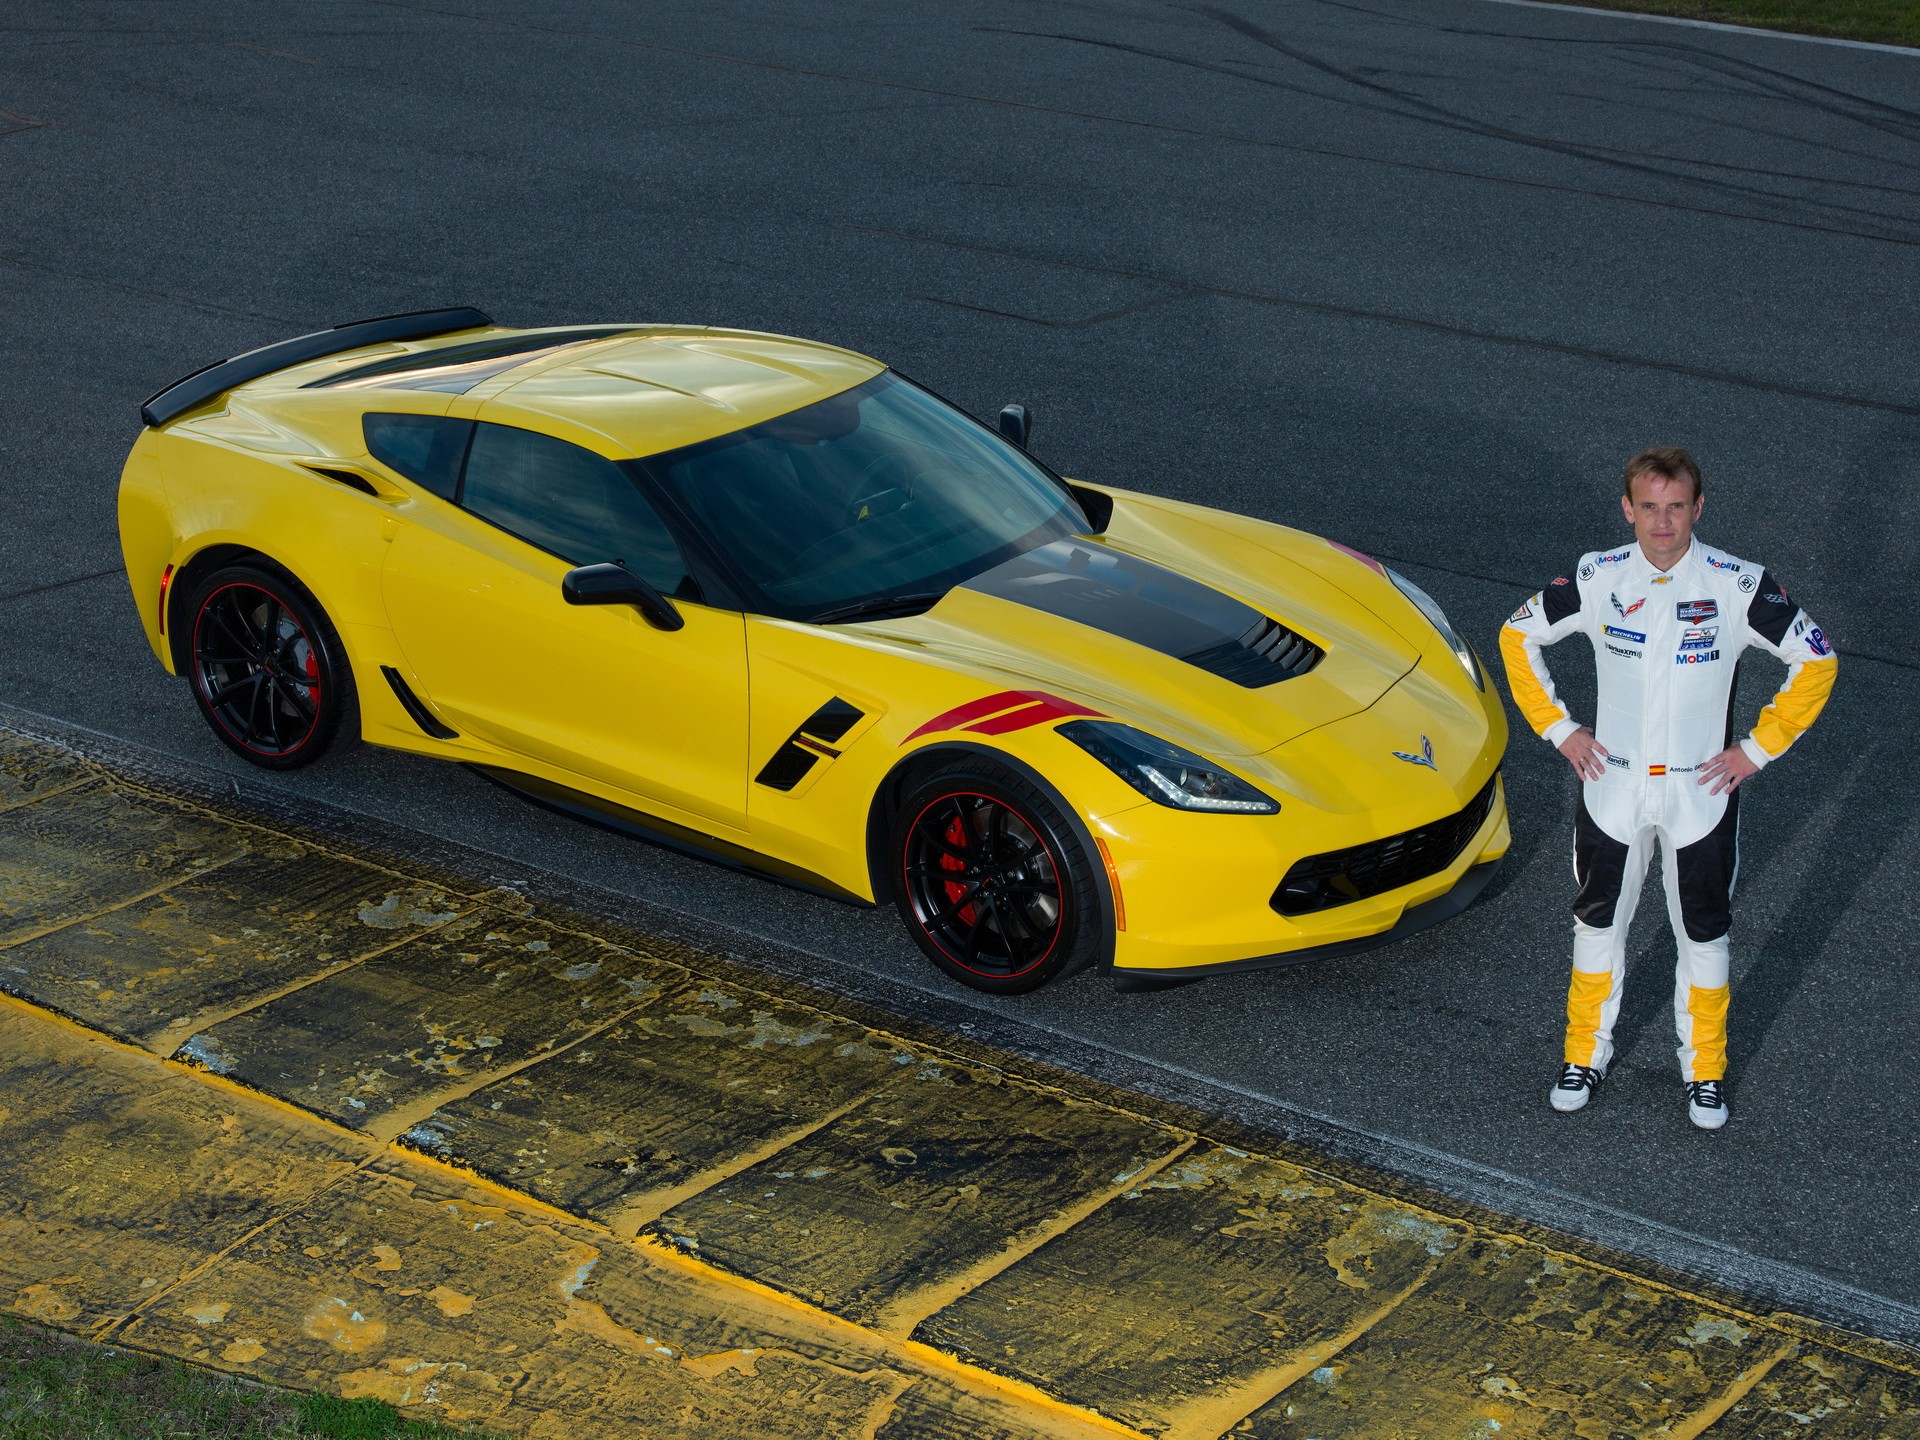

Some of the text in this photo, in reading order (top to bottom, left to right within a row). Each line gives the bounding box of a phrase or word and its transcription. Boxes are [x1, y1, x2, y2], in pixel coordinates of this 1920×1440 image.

[1598, 553, 1622, 564] Mobil
[1706, 556, 1731, 569] Mobil
[1581, 565, 1591, 577] 21
[1741, 578, 1753, 589] 21
[1611, 630, 1641, 640] MICHELIN
[1804, 628, 1827, 656] VP
[1676, 652, 1710, 665] Mobil
